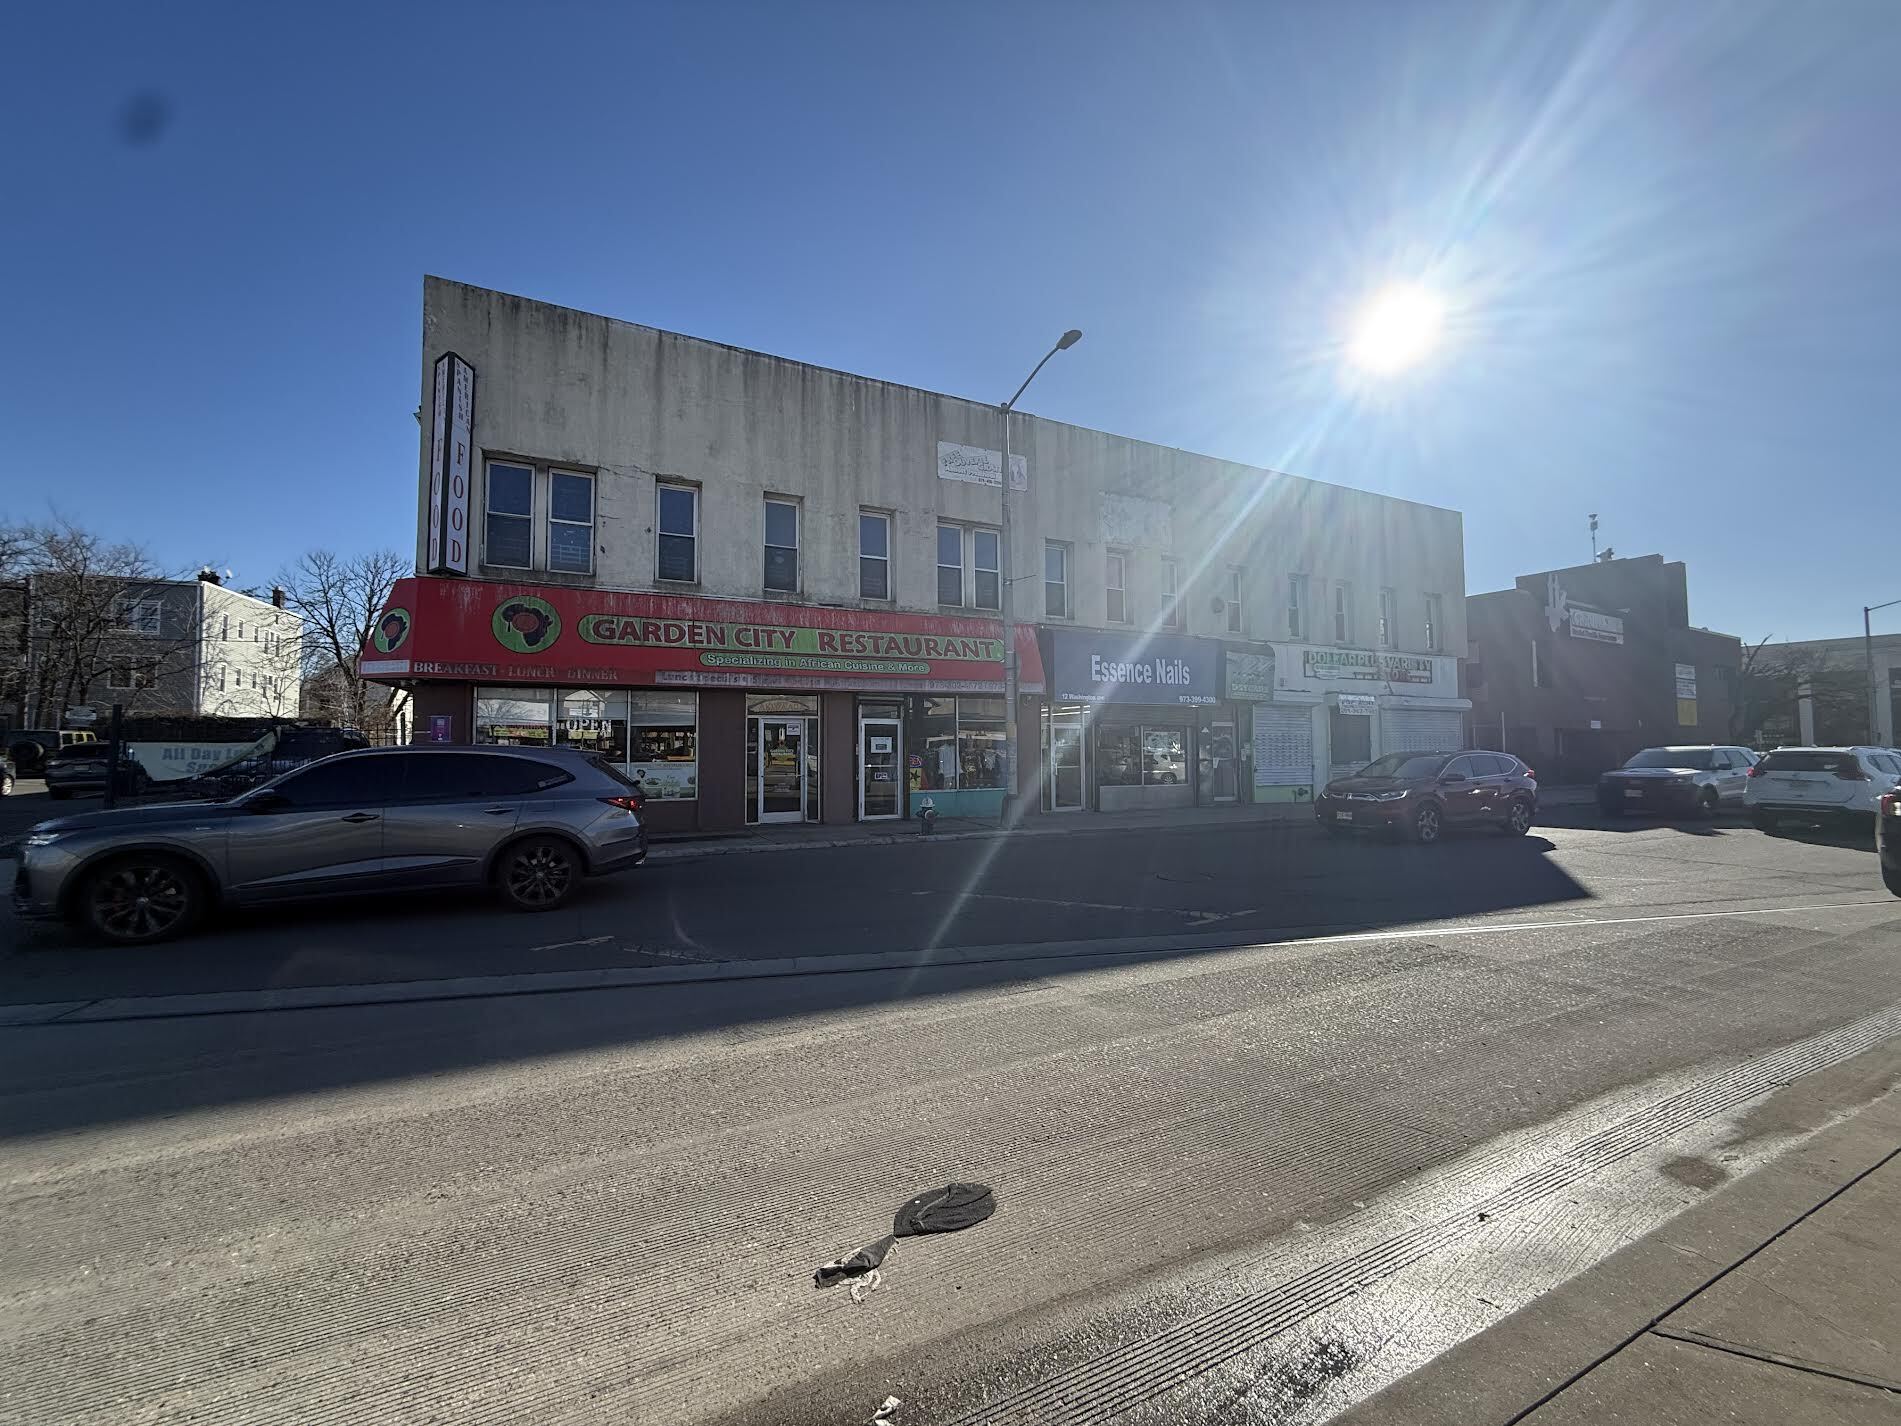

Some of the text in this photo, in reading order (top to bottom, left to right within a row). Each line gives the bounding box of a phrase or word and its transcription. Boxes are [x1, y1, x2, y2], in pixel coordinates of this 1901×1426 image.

[450, 441, 466, 564] FOOD
[592, 618, 797, 649] GARDEN CITY
[817, 631, 995, 659] RESTAURANT
[413, 661, 497, 677] BREAKFAST
[567, 668, 618, 681] DINNER
[707, 653, 926, 672] Specializing in African Cuisine & More
[1091, 654, 1190, 685] Essence Nails
[565, 719, 612, 733] OPEN
[162, 747, 185, 761] All
[191, 747, 221, 762] Day
